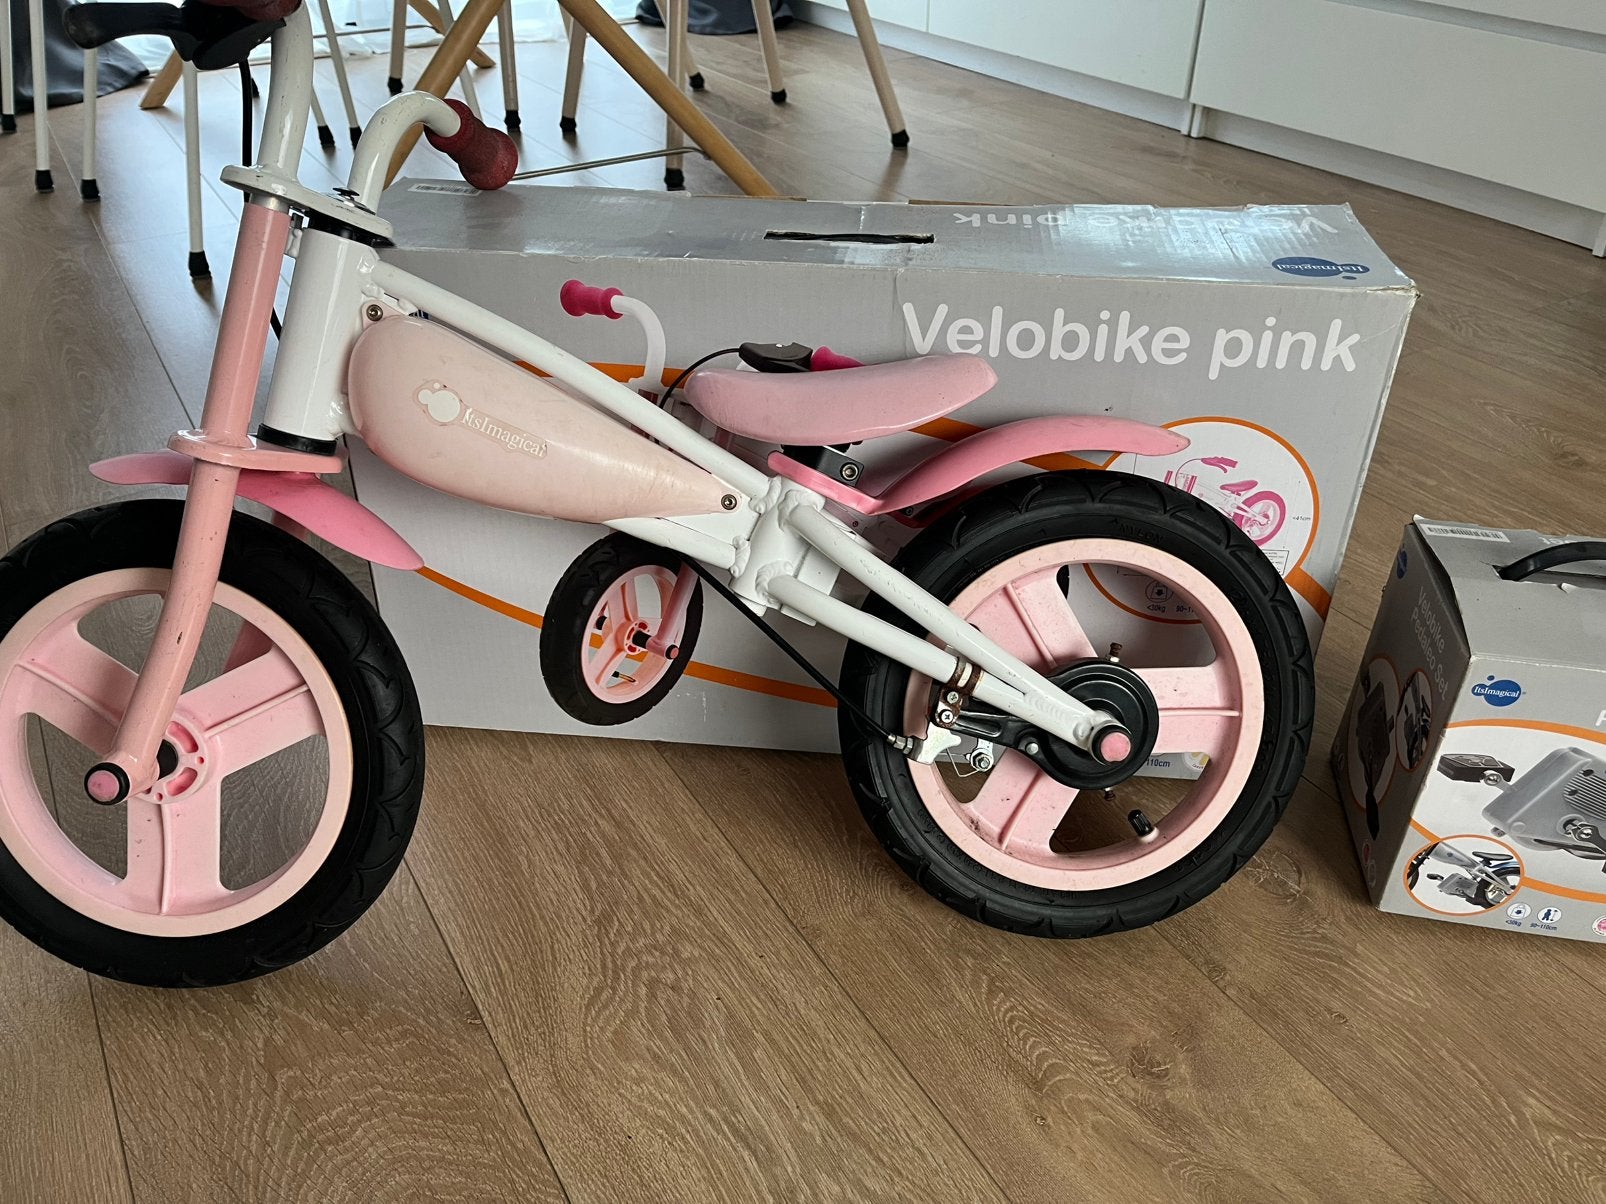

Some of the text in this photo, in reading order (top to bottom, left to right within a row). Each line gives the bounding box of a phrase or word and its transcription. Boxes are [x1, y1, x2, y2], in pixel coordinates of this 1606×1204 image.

[952, 210, 1067, 229] pink
[1276, 262, 1365, 273] ItsImagical
[901, 302, 1361, 381] Velobike pink
[1418, 585, 1446, 654] Velobike
[1411, 606, 1449, 700] Pedaleo Set
[1473, 685, 1520, 698] ItsImagical
